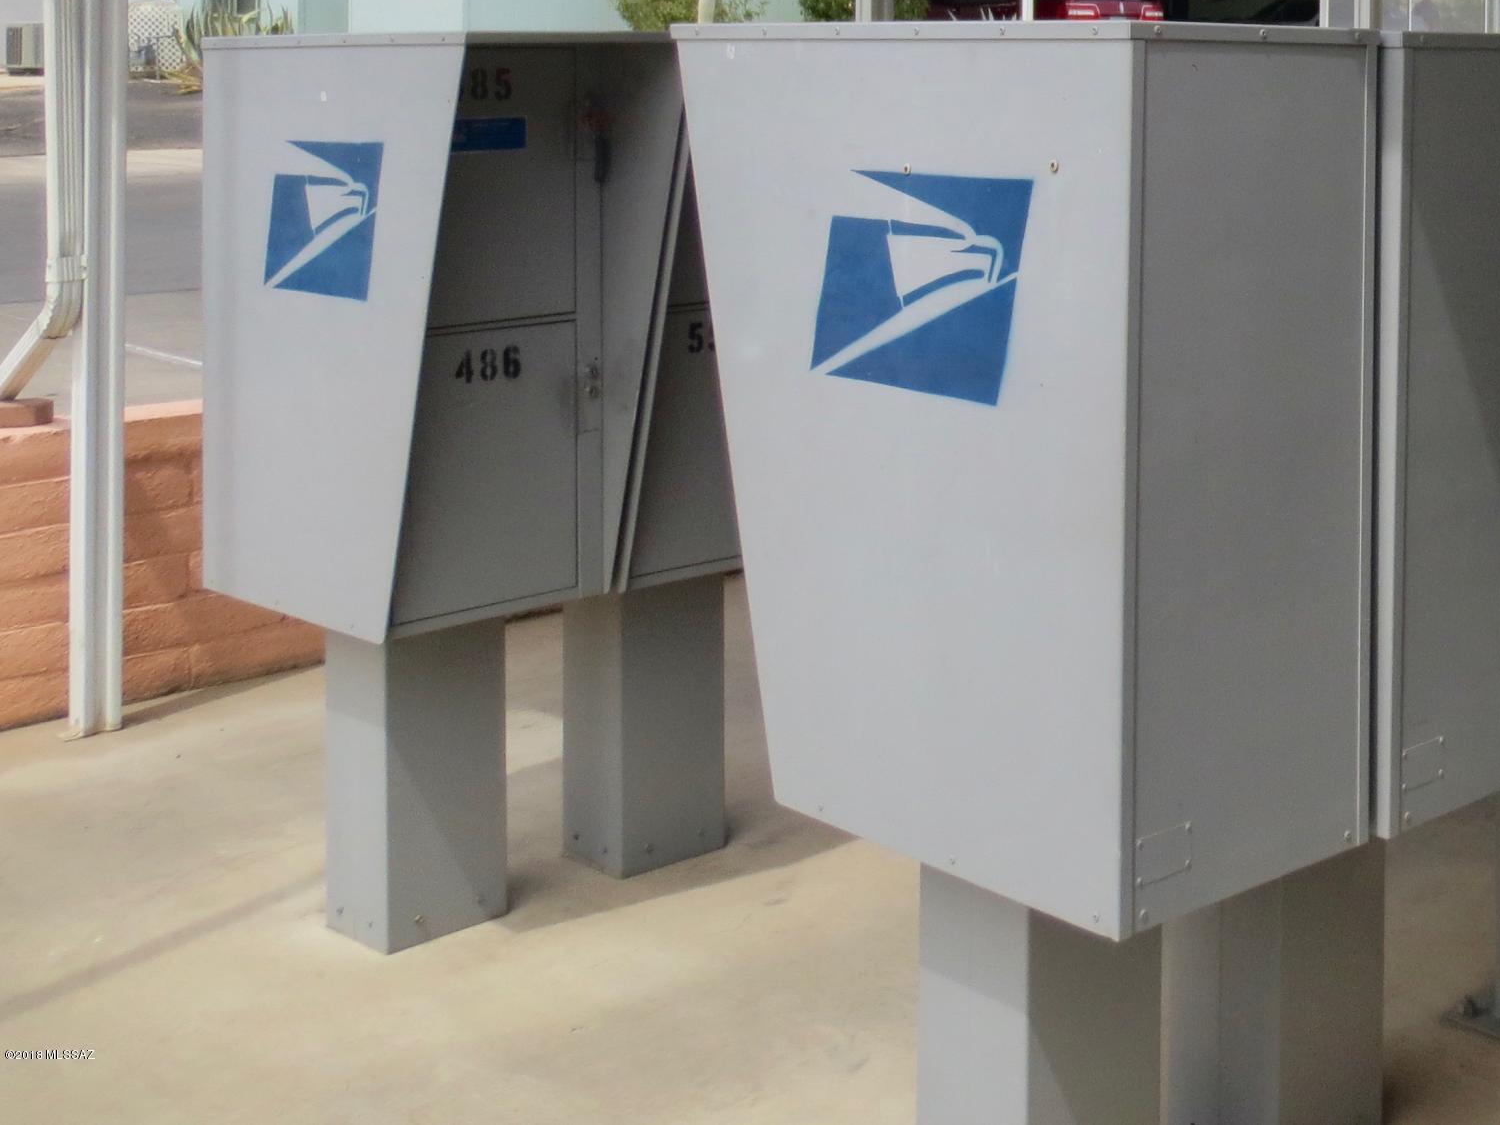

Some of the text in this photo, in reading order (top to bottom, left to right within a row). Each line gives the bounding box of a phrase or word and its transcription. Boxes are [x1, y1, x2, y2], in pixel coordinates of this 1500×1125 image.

[459, 67, 512, 101] 85
[688, 321, 715, 354] 5
[455, 344, 521, 383] 486
